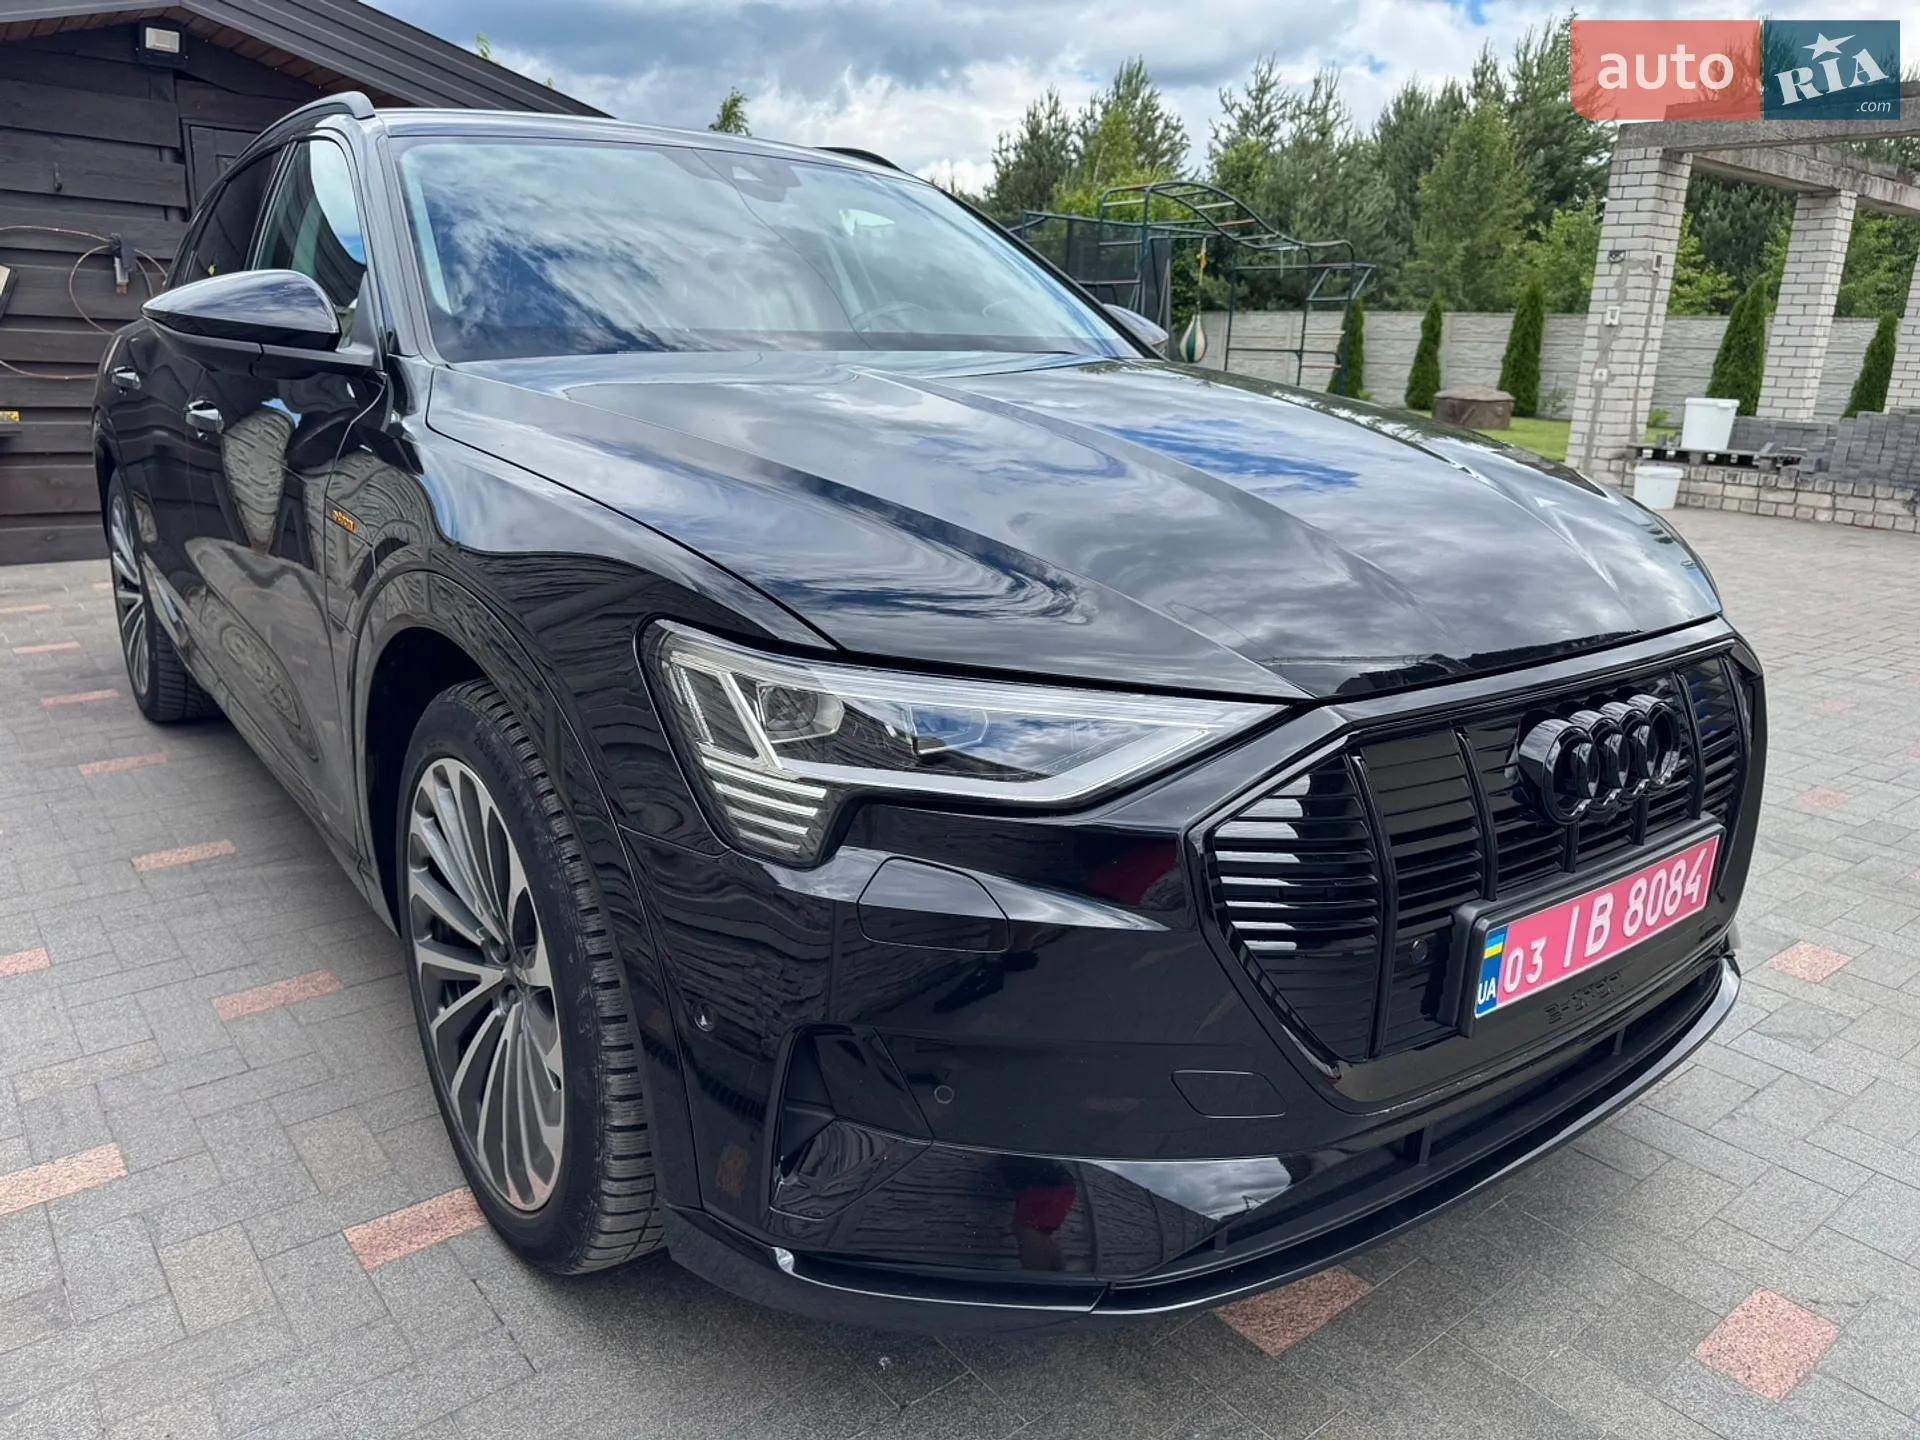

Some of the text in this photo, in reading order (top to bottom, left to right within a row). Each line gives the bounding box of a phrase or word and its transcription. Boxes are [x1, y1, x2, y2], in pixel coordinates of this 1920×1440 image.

[1503, 847, 1707, 993] 03 IB 8084
[1478, 977, 1496, 1004] UA
